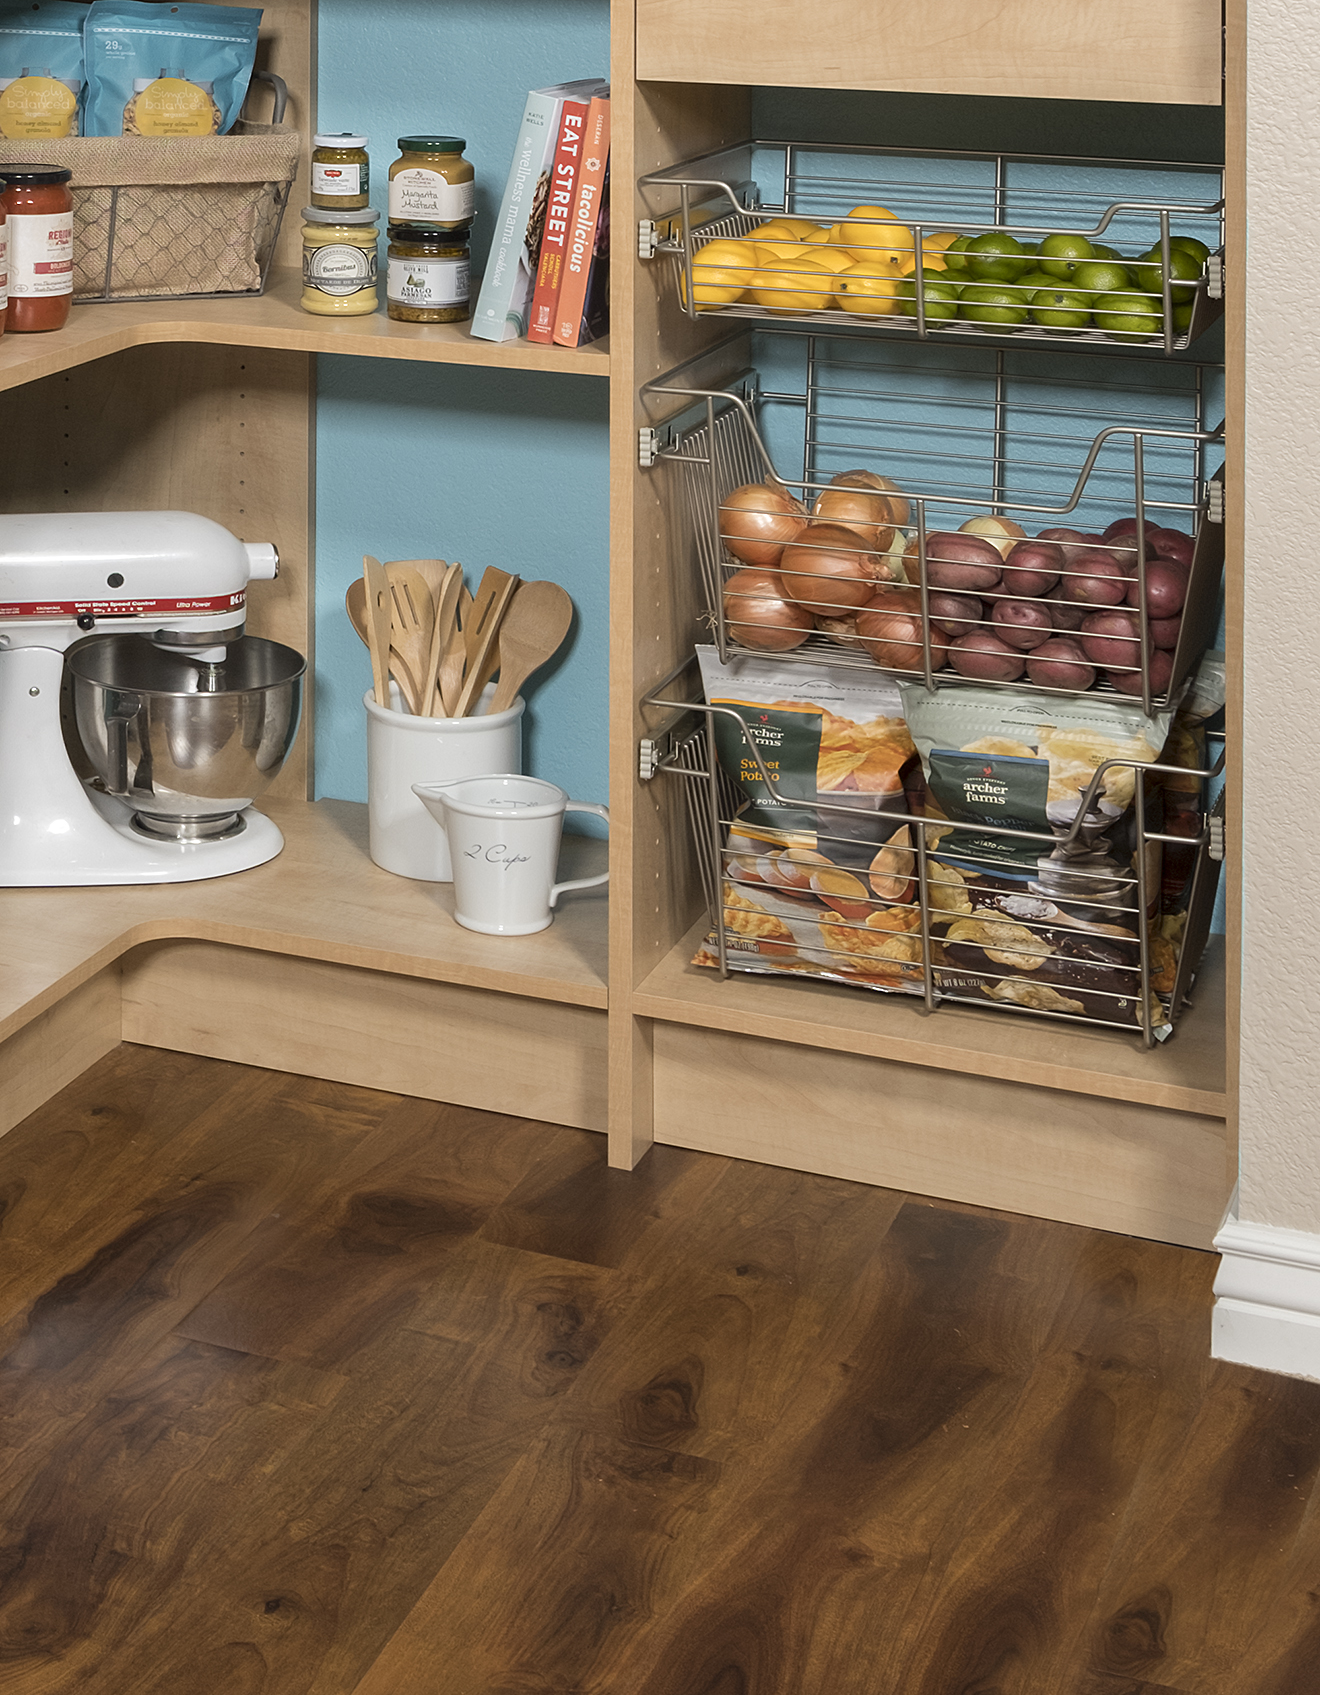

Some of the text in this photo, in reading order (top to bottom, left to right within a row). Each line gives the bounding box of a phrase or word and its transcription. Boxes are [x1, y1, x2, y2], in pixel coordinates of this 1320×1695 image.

[12, 84, 68, 106] Simply
[151, 85, 202, 103] Simply
[25, 110, 52, 118] organic
[163, 111, 189, 119] organic
[528, 112, 544, 120] KATIE
[15, 120, 36, 128] honey
[153, 120, 174, 128] honey
[526, 118, 544, 126] WELLS
[511, 149, 533, 203] wellness
[547, 114, 582, 247] EAT STREET
[401, 189, 439, 202] Margarita
[401, 200, 439, 211] Mustard
[502, 205, 519, 245] mama
[569, 184, 597, 273] tacolicious
[492, 246, 507, 287] cookbook
[401, 286, 432, 294] ASIAGO
[963, 781, 1008, 795] archer
[965, 791, 1007, 805] farms
[463, 844, 532, 871] 2 Cups
